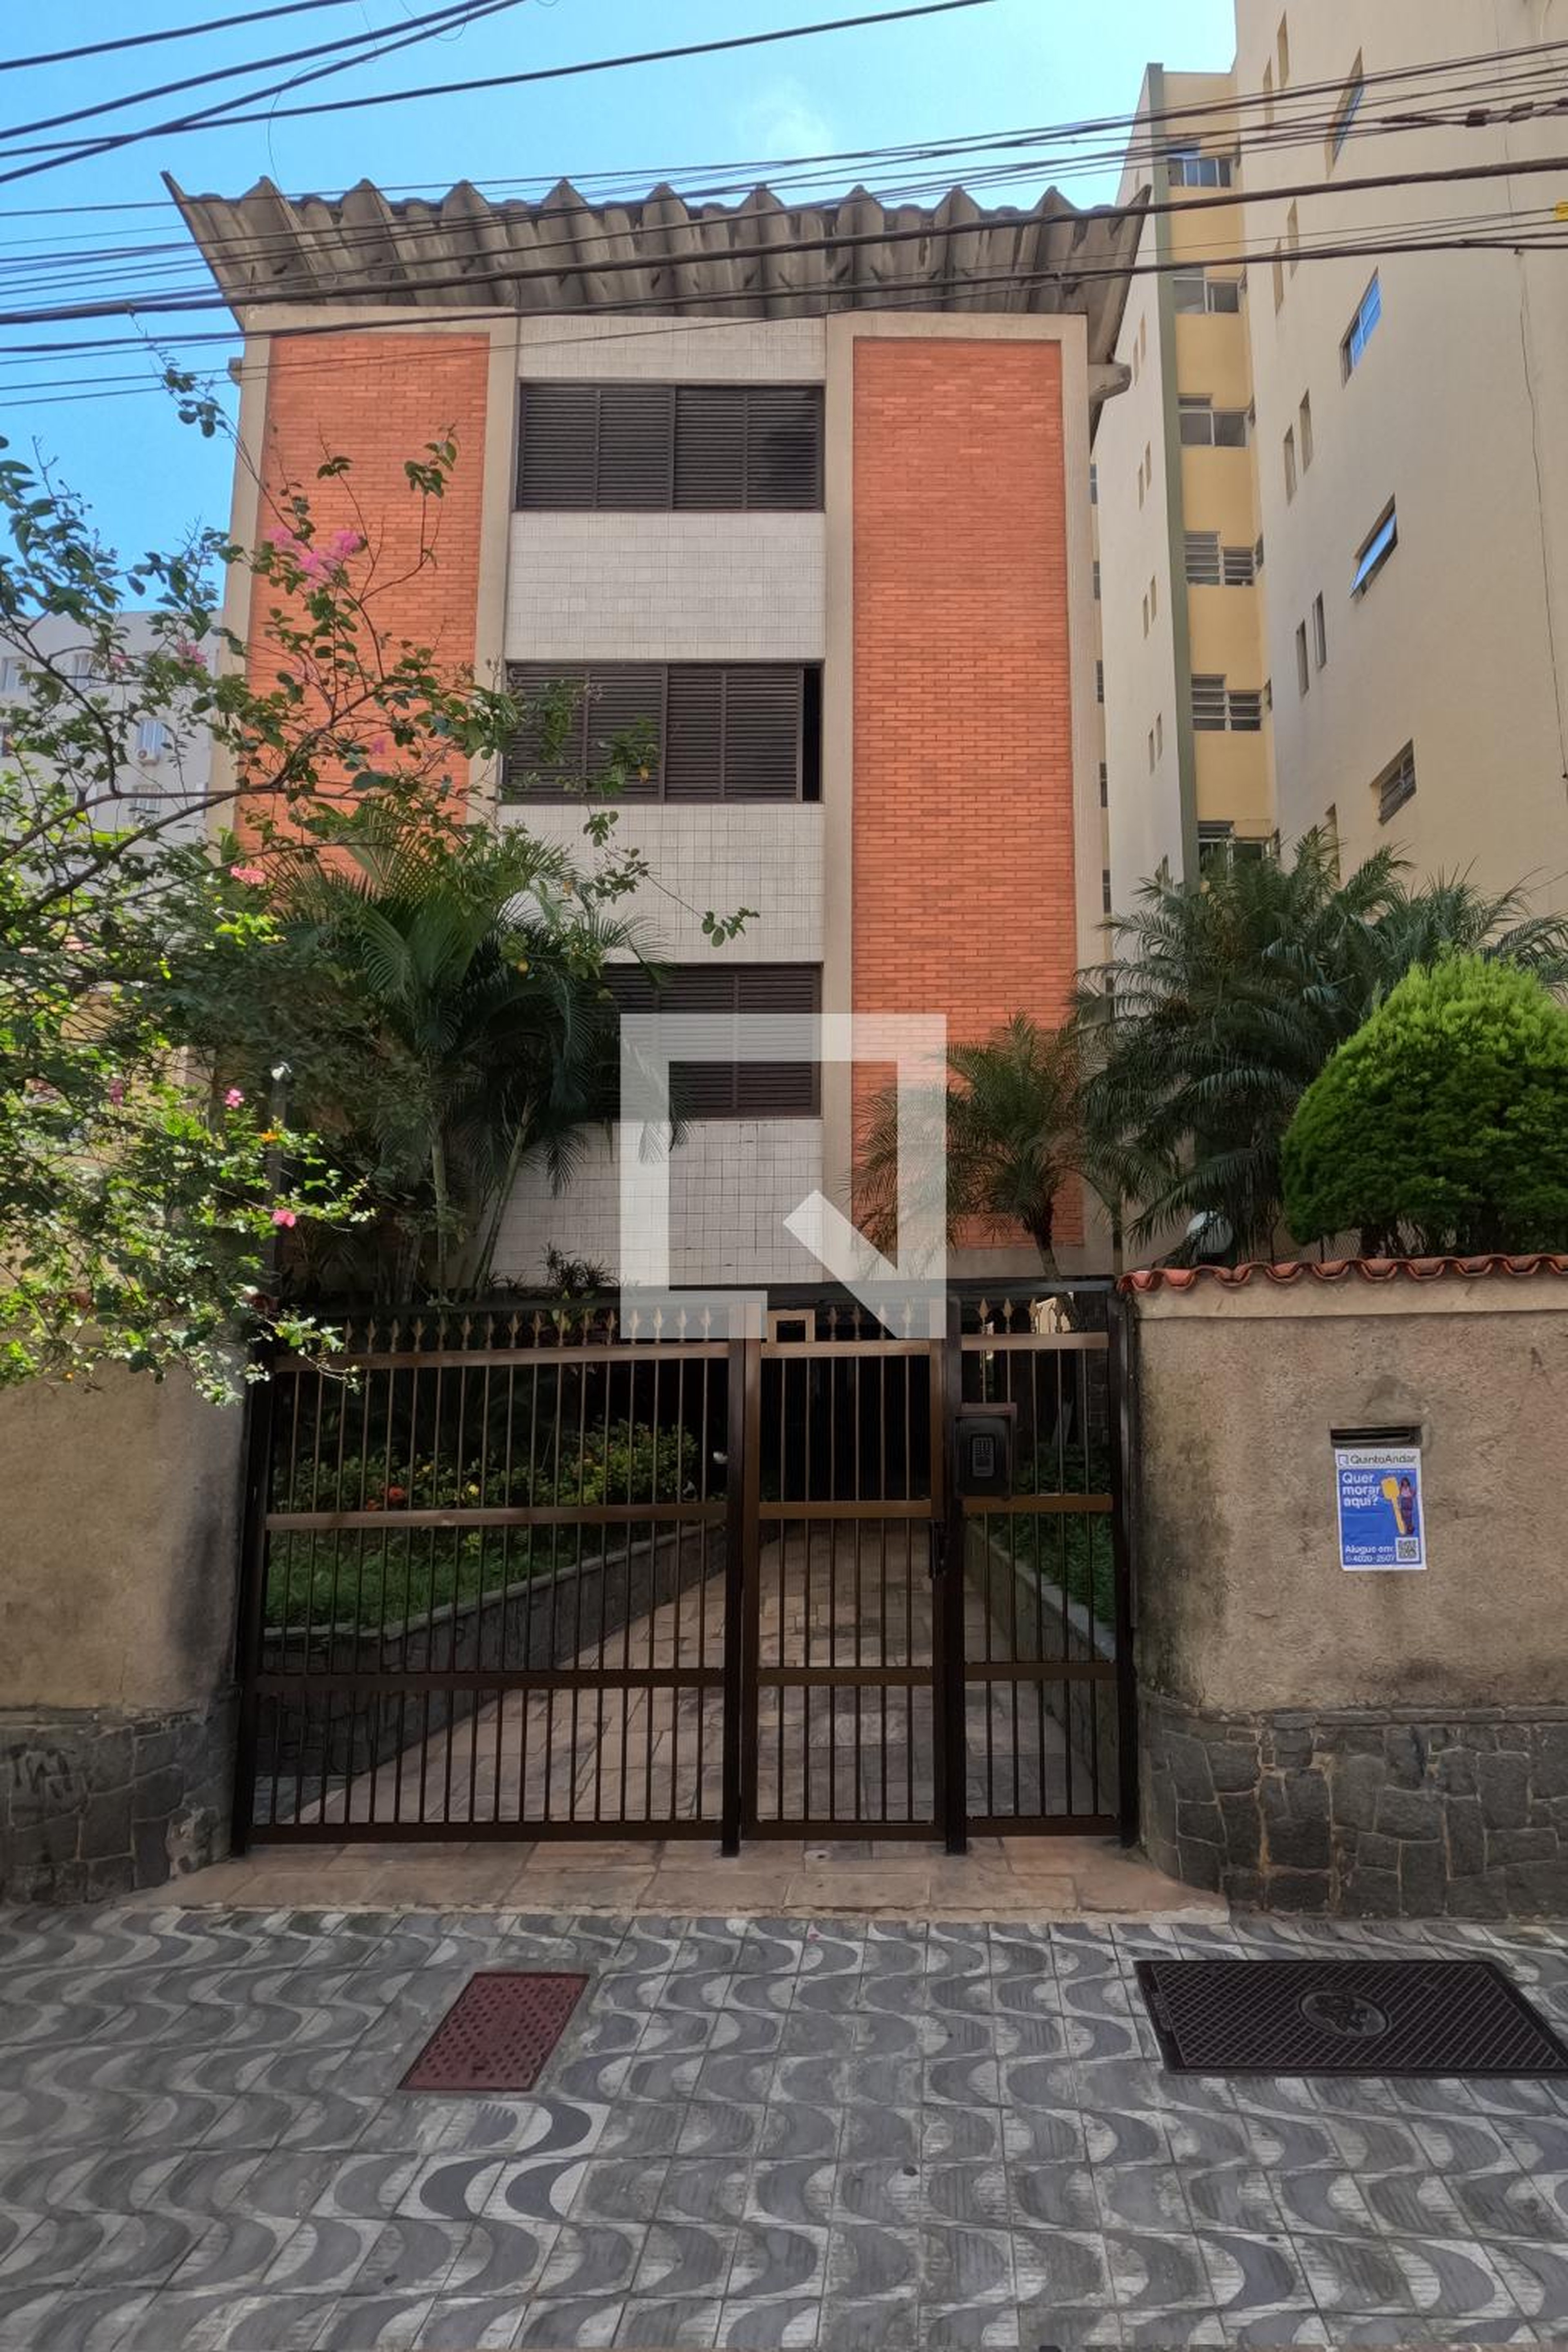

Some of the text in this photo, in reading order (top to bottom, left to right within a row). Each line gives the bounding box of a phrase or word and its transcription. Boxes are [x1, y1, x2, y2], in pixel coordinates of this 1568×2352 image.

[1342, 1472, 1374, 1483] Quer
[1342, 1486, 1380, 1495] morar
[1343, 1494, 1378, 1509] aqui?
